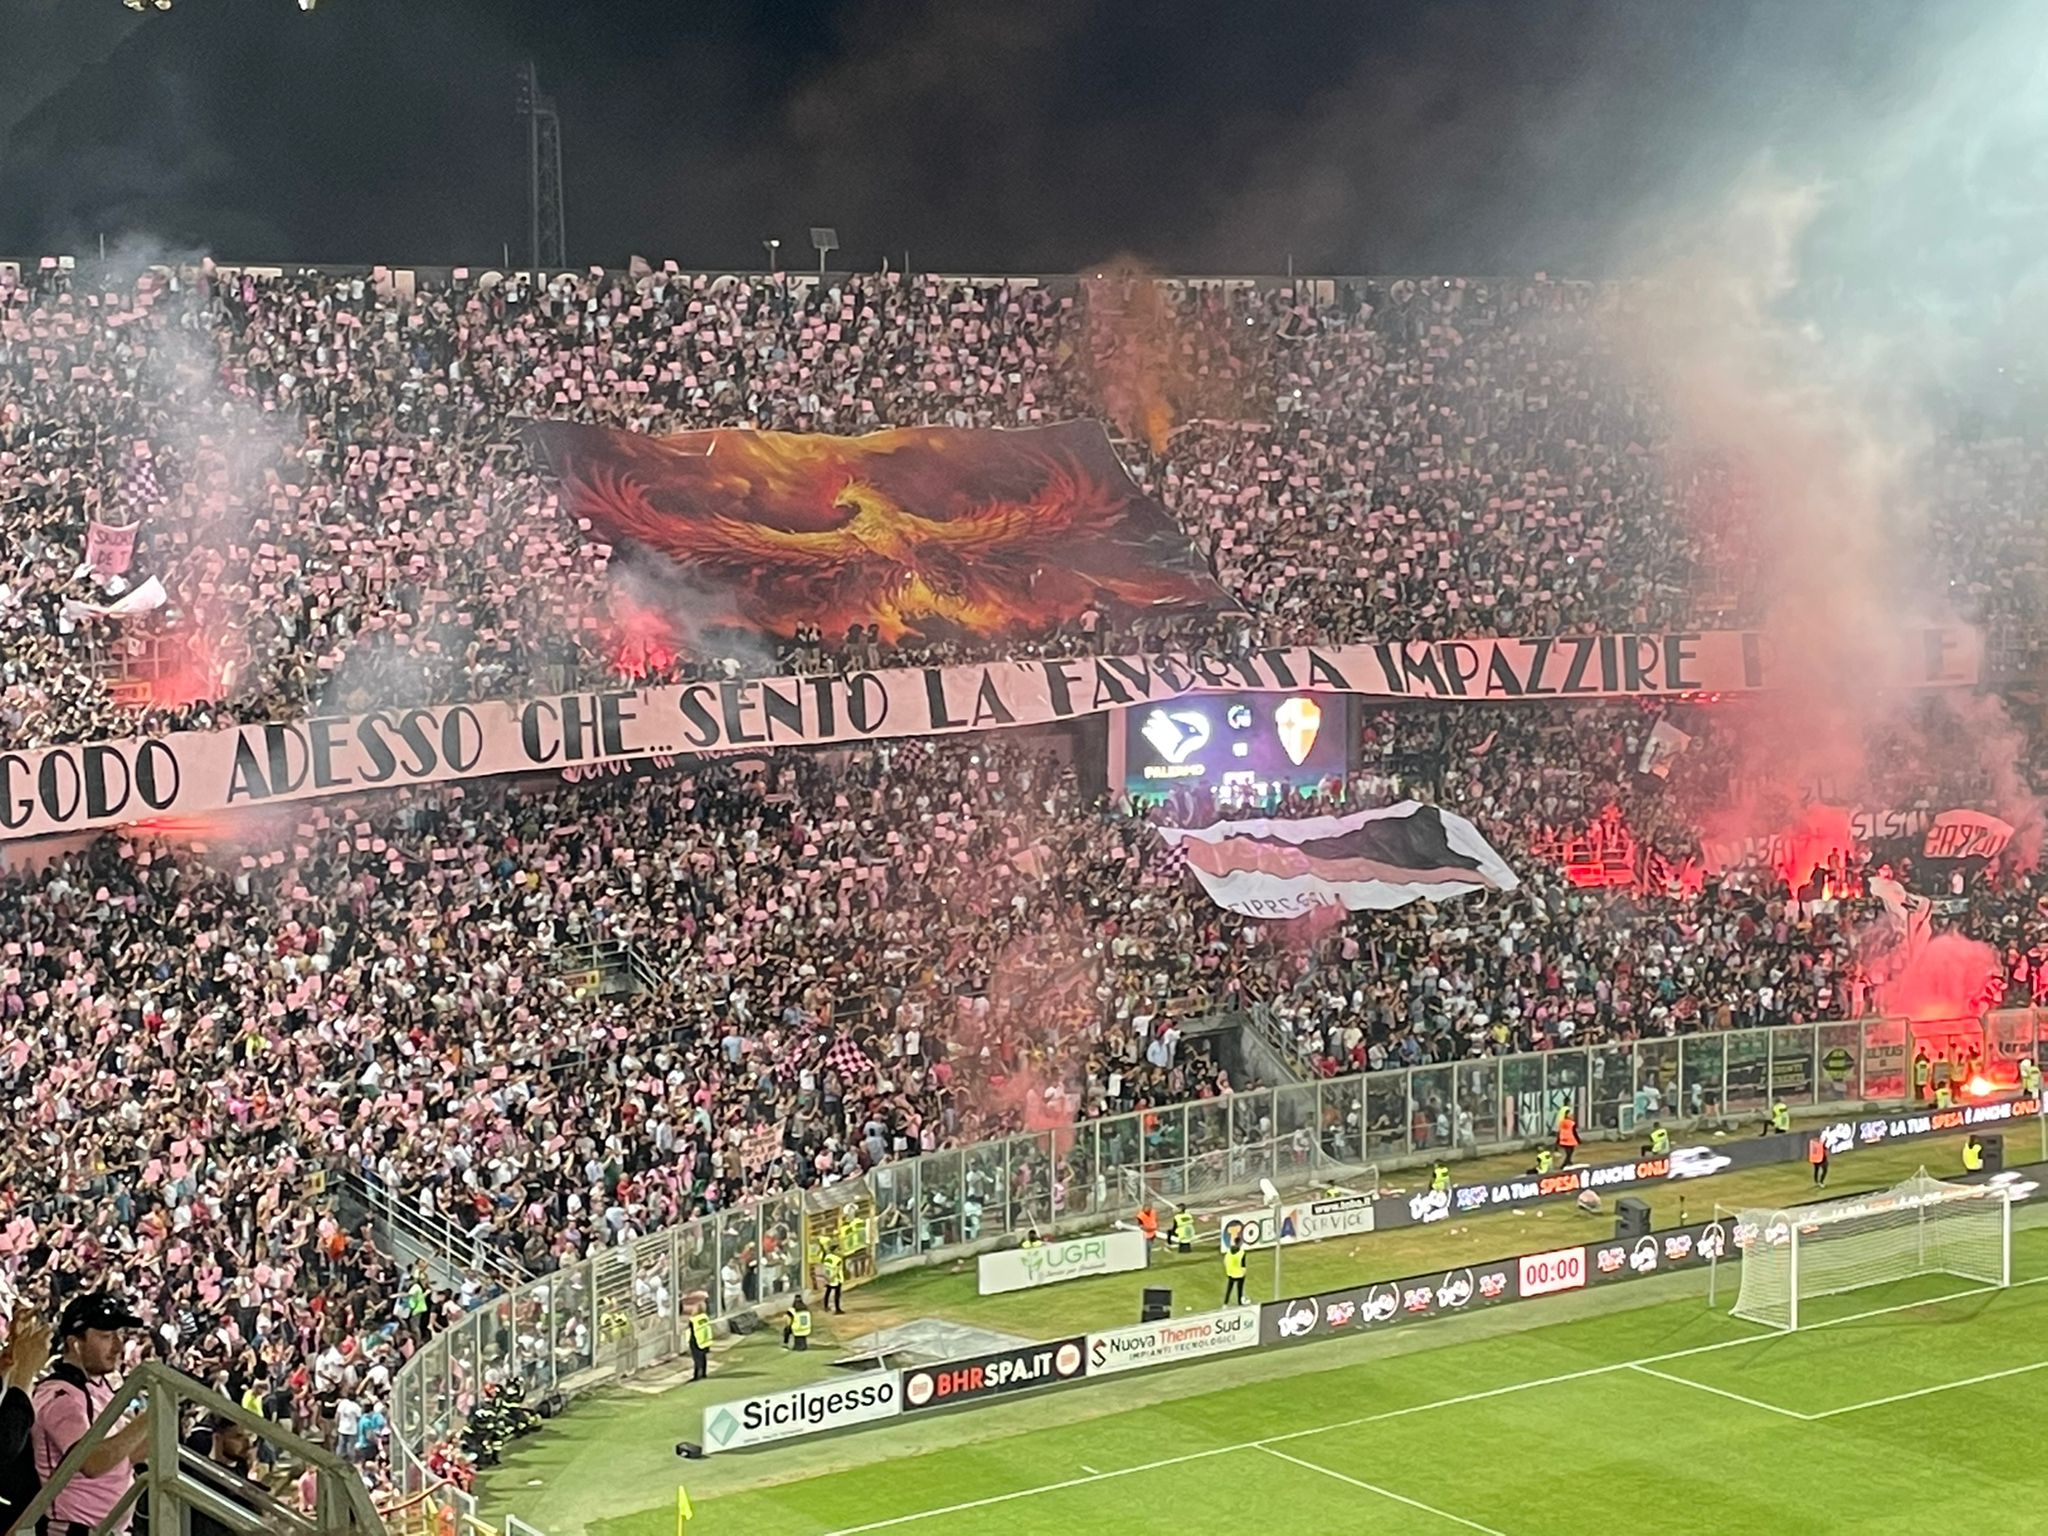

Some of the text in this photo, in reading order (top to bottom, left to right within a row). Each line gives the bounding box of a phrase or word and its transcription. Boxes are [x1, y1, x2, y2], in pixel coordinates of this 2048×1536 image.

[0, 739, 180, 829] GODO
[227, 706, 484, 804] ADESSO
[679, 670, 889, 748] SENTO
[927, 667, 1014, 731] LA
[1373, 634, 1703, 697] IMPAZZIRE
[1046, 1240, 1106, 1267] UGRI
[1526, 1257, 1579, 1286] 00:00
[1110, 1335, 1155, 1354] Nuova
[1159, 1324, 1212, 1345] Thermo
[1215, 1315, 1242, 1335] Sud
[936, 1352, 1053, 1398] BHRSPA.IT
[742, 1382, 894, 1431] Sicilgesso
